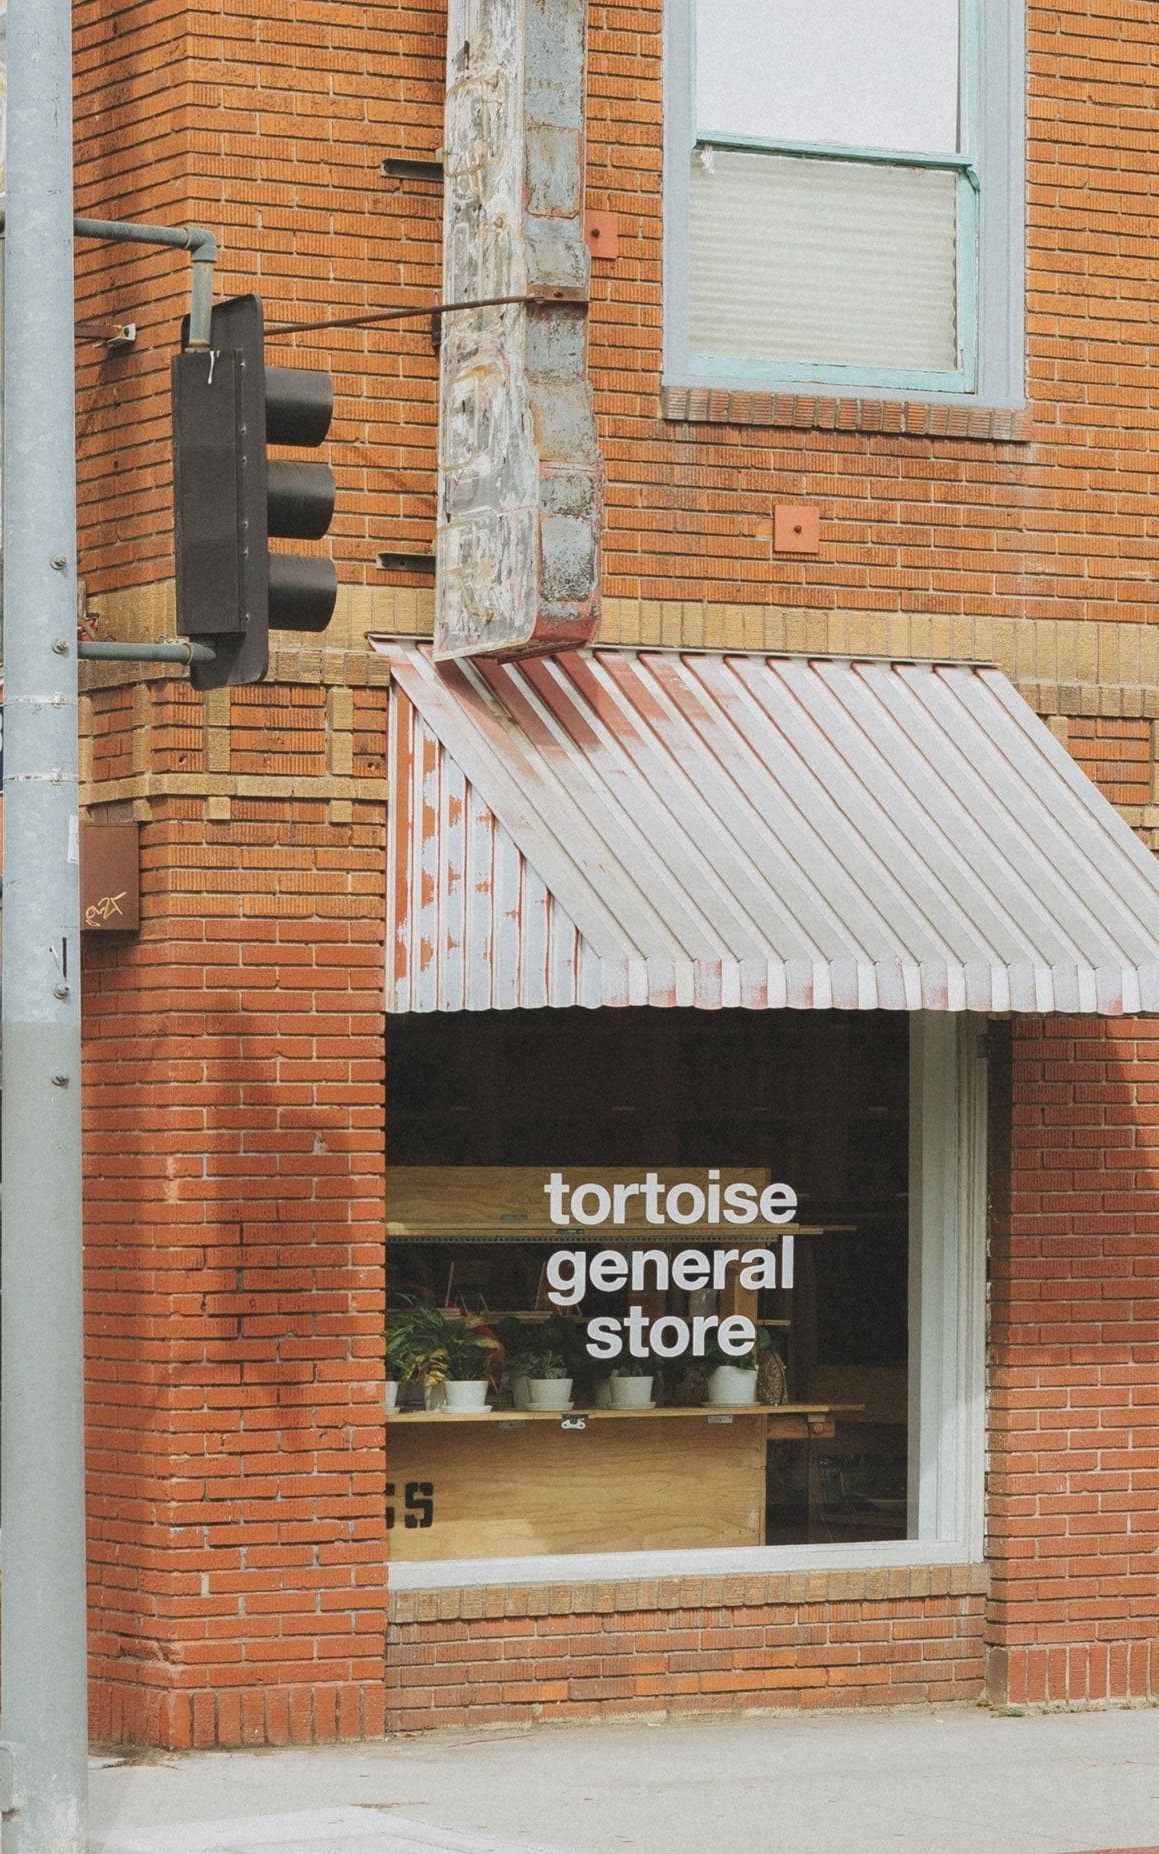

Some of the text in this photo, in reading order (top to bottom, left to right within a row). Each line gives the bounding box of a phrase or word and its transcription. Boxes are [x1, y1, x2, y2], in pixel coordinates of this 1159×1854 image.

[544, 1169, 798, 1225] tortoise
[546, 1235, 795, 1306] general
[586, 1305, 756, 1359] store
